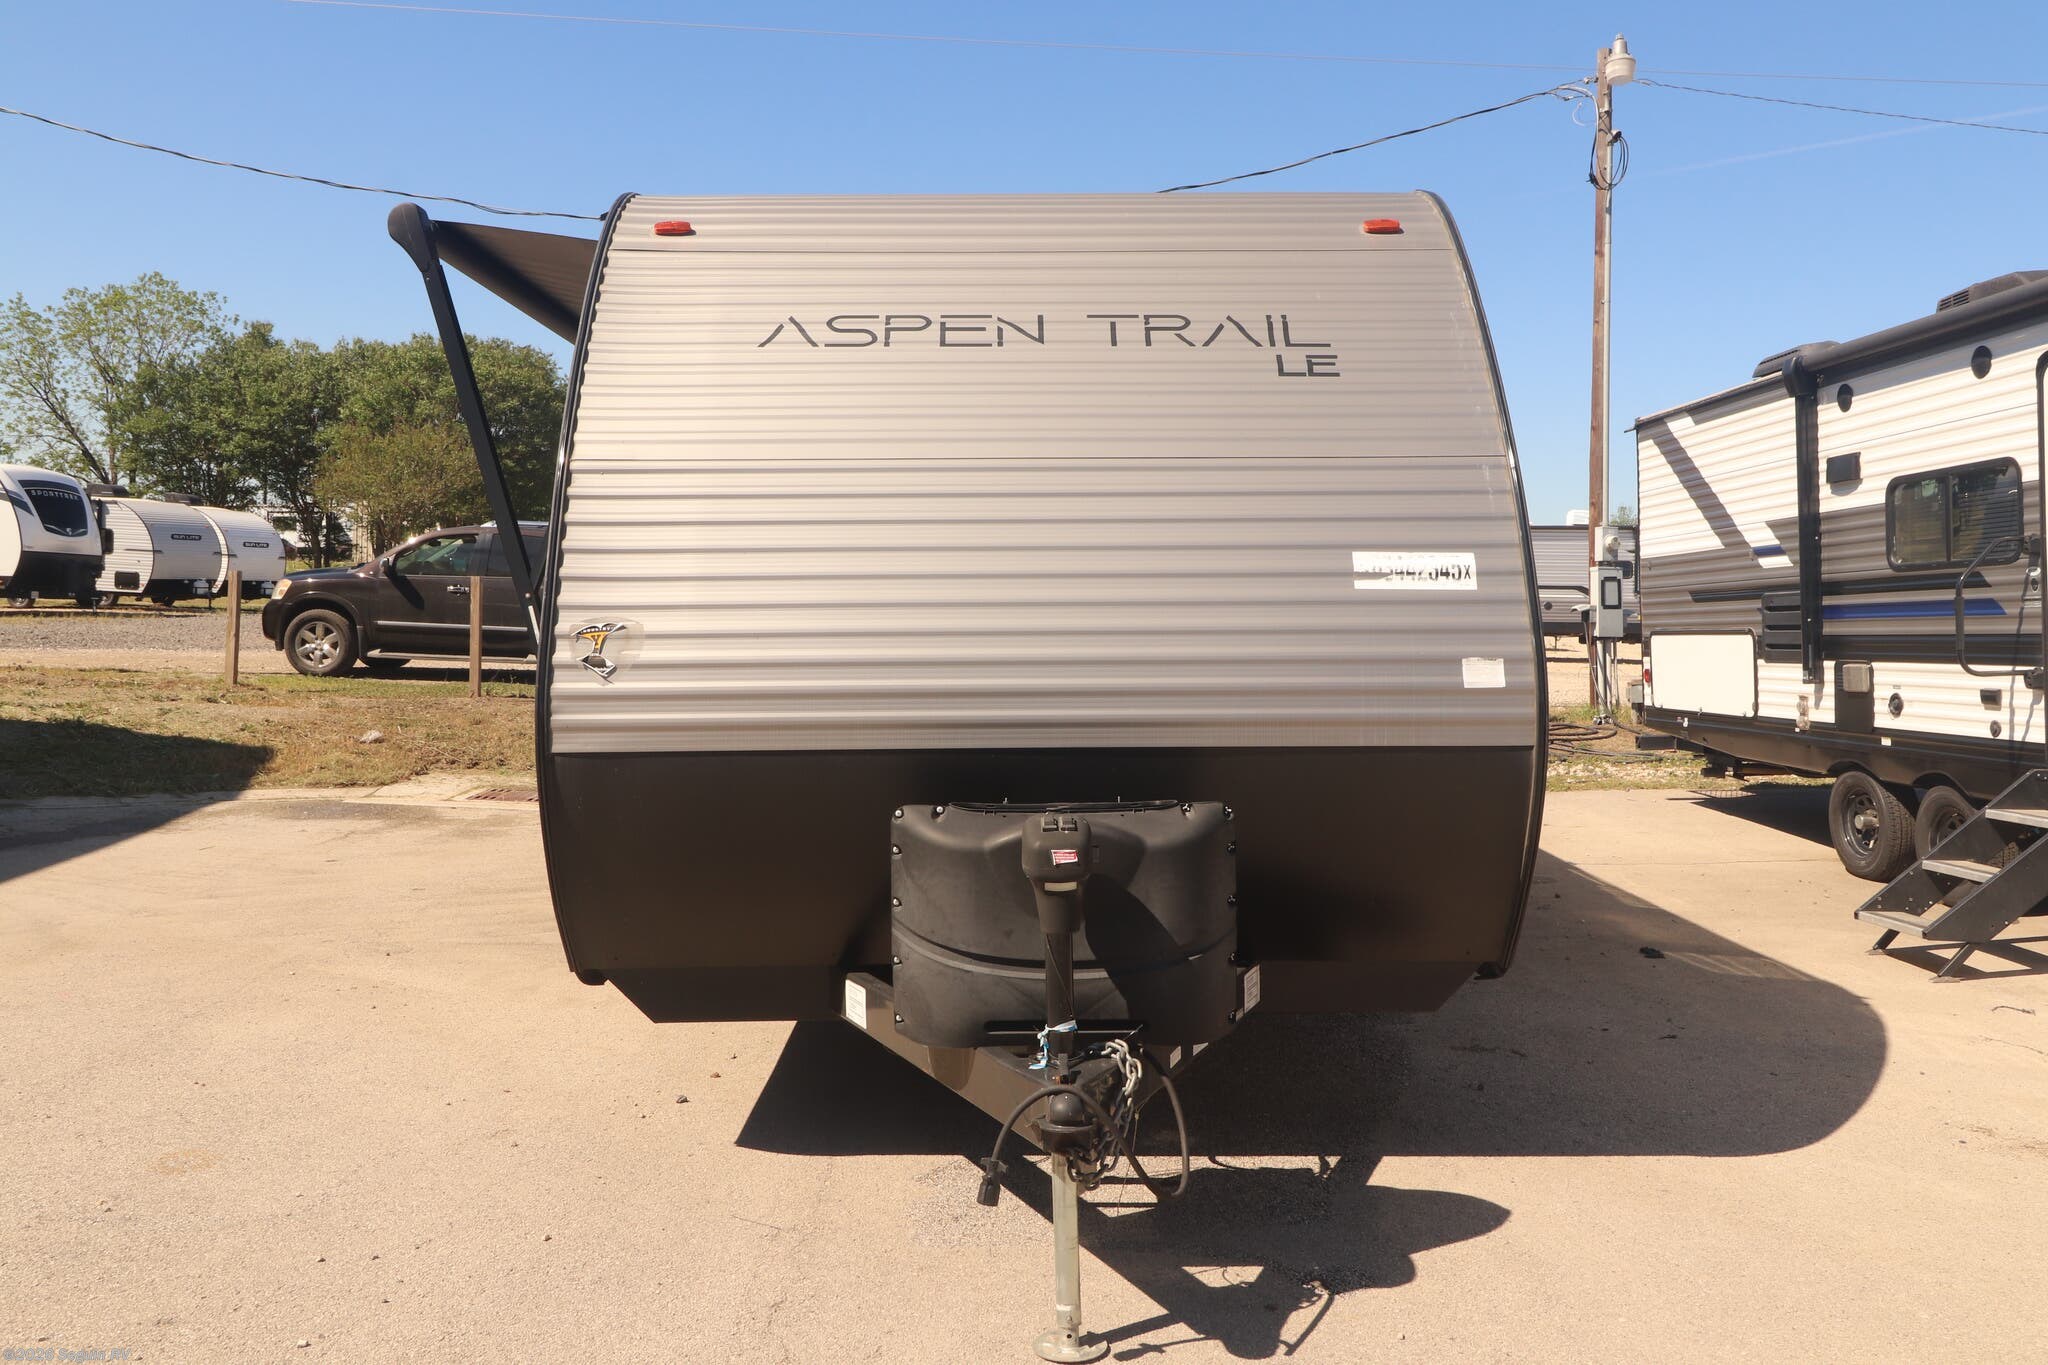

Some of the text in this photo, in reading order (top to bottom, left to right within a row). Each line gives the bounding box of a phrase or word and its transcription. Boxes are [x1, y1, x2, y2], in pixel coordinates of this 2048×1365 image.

[757, 314, 1332, 348] ASPEN TRAIL
[1275, 353, 1341, 378] LE
